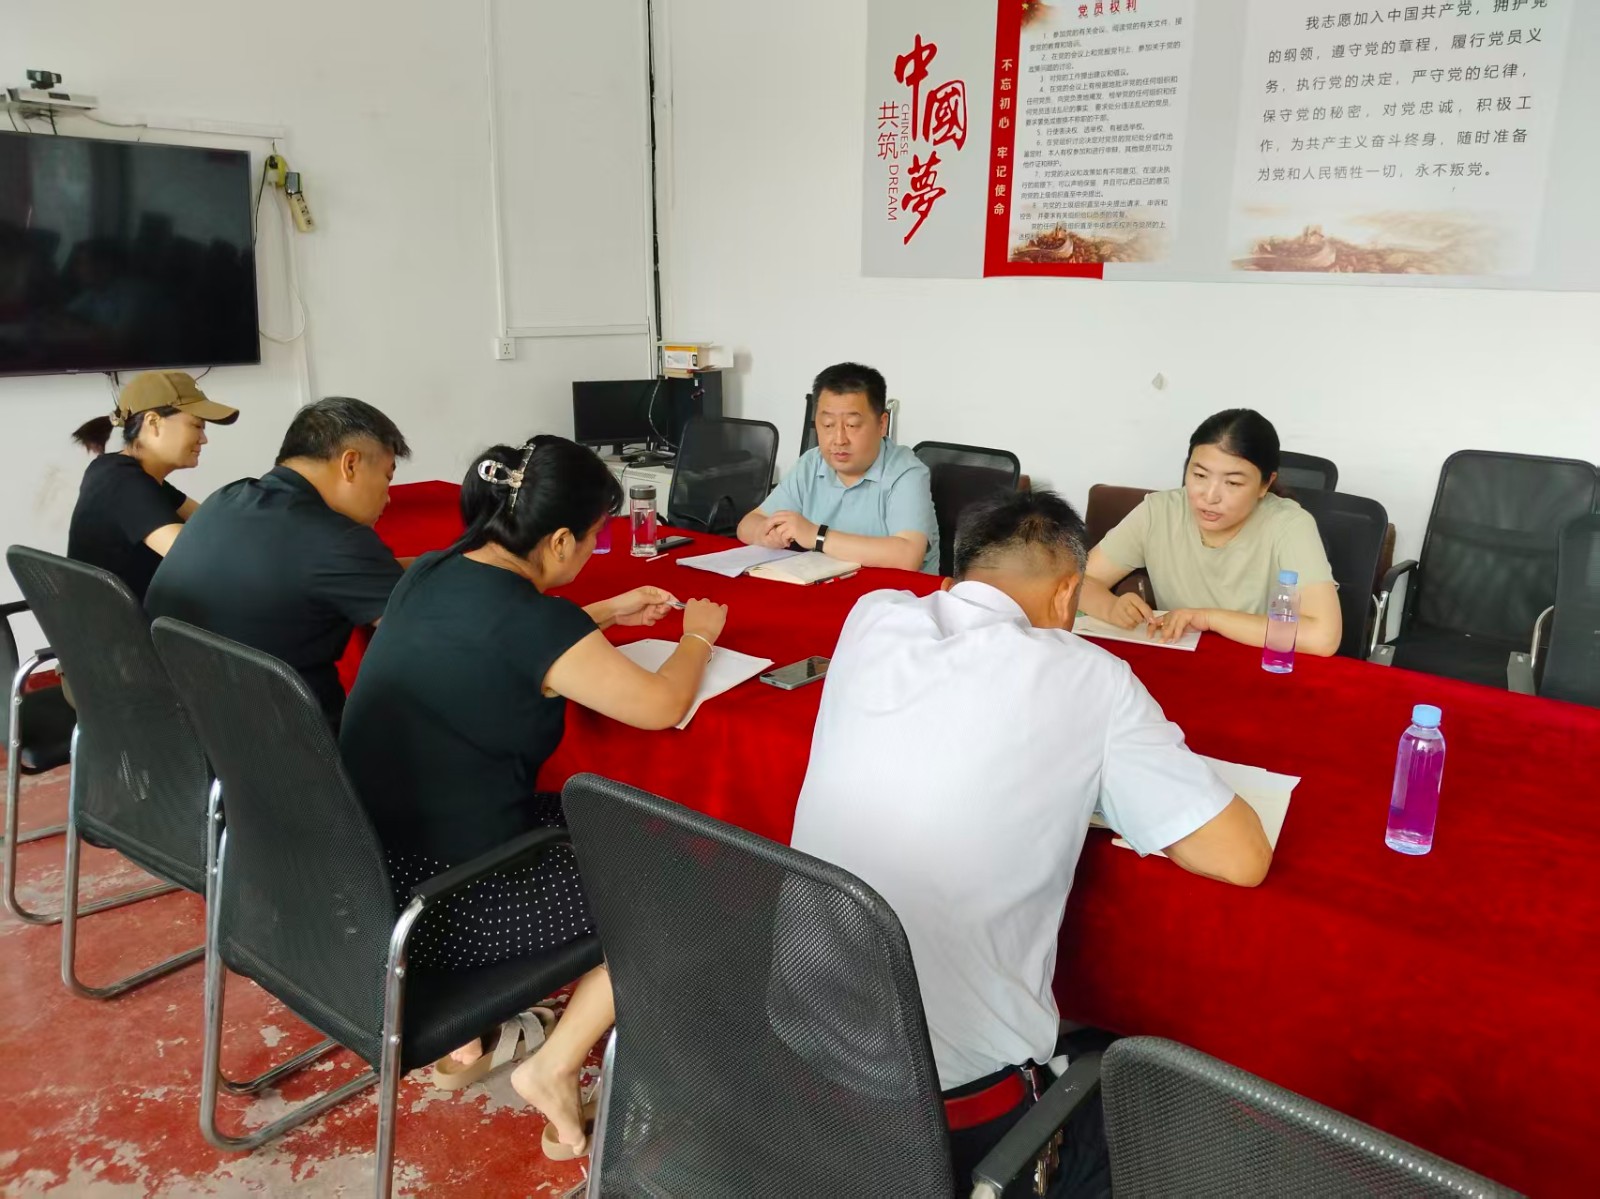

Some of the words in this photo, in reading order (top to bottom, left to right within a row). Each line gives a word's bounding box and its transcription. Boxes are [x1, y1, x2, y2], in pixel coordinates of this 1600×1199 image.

[1077, 0, 1137, 18] 党员权利
[1268, 27, 1542, 64] 的纲领，遵守党的章程，履行党员义
[998, 59, 1013, 129] 不忘初心
[1265, 63, 1528, 95] 务，执行党的决定，严守党的纪律，
[877, 101, 899, 160] 共筑
[900, 103, 909, 156] CHINESE
[1263, 95, 1533, 123] 保守党的秘密，对党忠诚，积极工
[894, 33, 967, 245] 中國夢
[1260, 128, 1528, 153] 作，为共产主义奋斗终身，随时准备
[888, 165, 899, 221] DREAM
[993, 147, 1008, 216] 牢记使命
[1257, 162, 1492, 182] 为党和人民牺牲一切，永不叛党。
